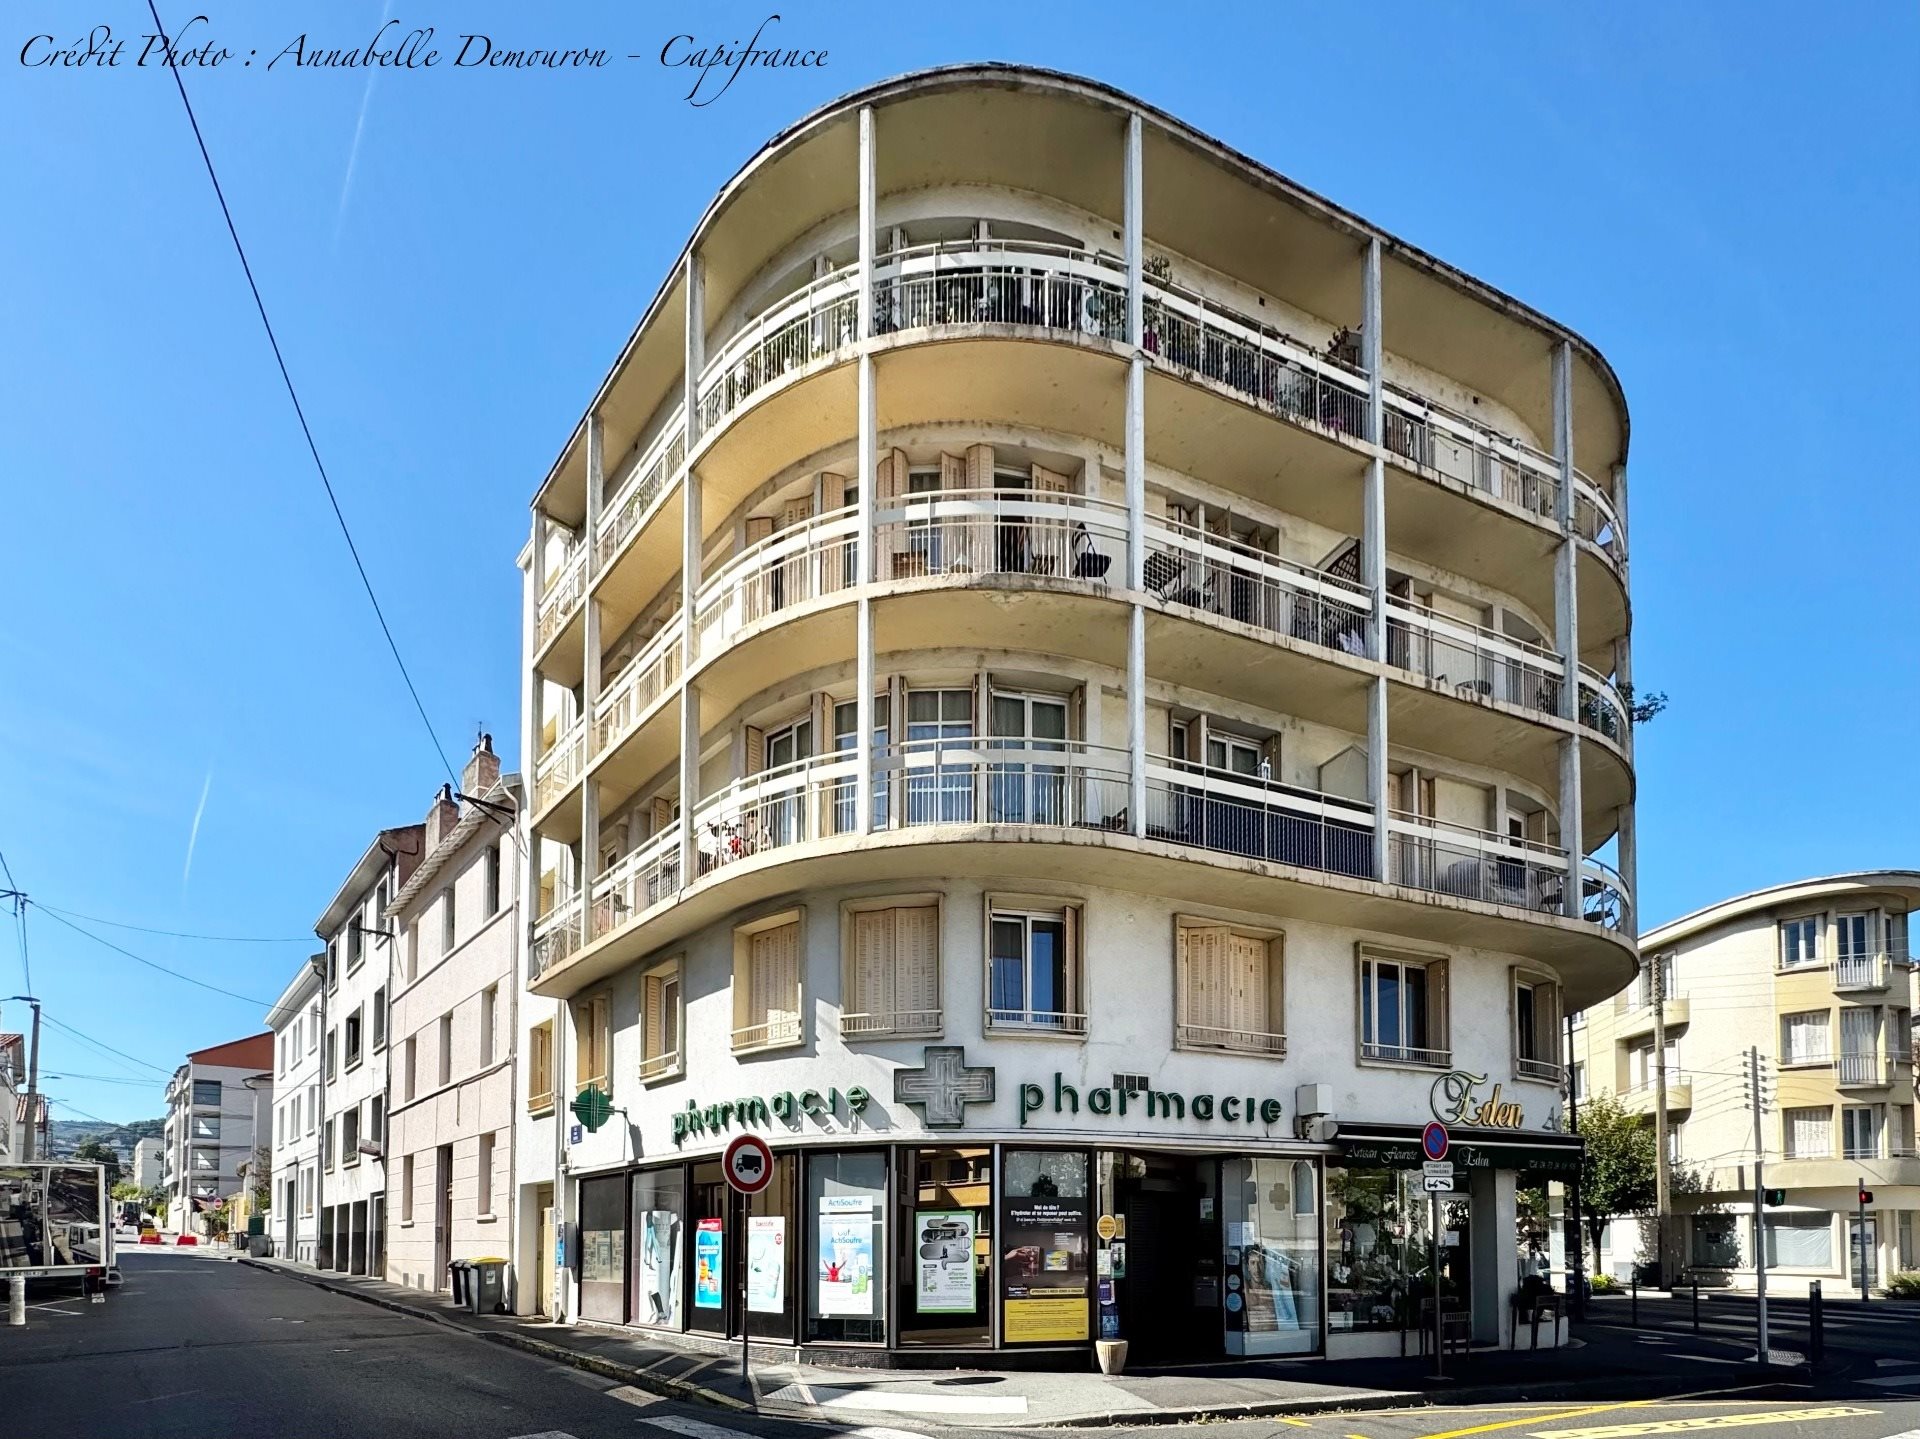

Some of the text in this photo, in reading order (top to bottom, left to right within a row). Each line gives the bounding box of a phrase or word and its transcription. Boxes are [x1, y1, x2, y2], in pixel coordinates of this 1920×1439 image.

[671, 1085, 869, 1145] pharmacie
[1020, 1072, 1281, 1125] pharmacie
[1430, 1071, 1523, 1128] Eden
[1346, 1144, 1489, 1167] Artisan Fleuriste Eden
[828, 1199, 863, 1207] ActiSoufre
